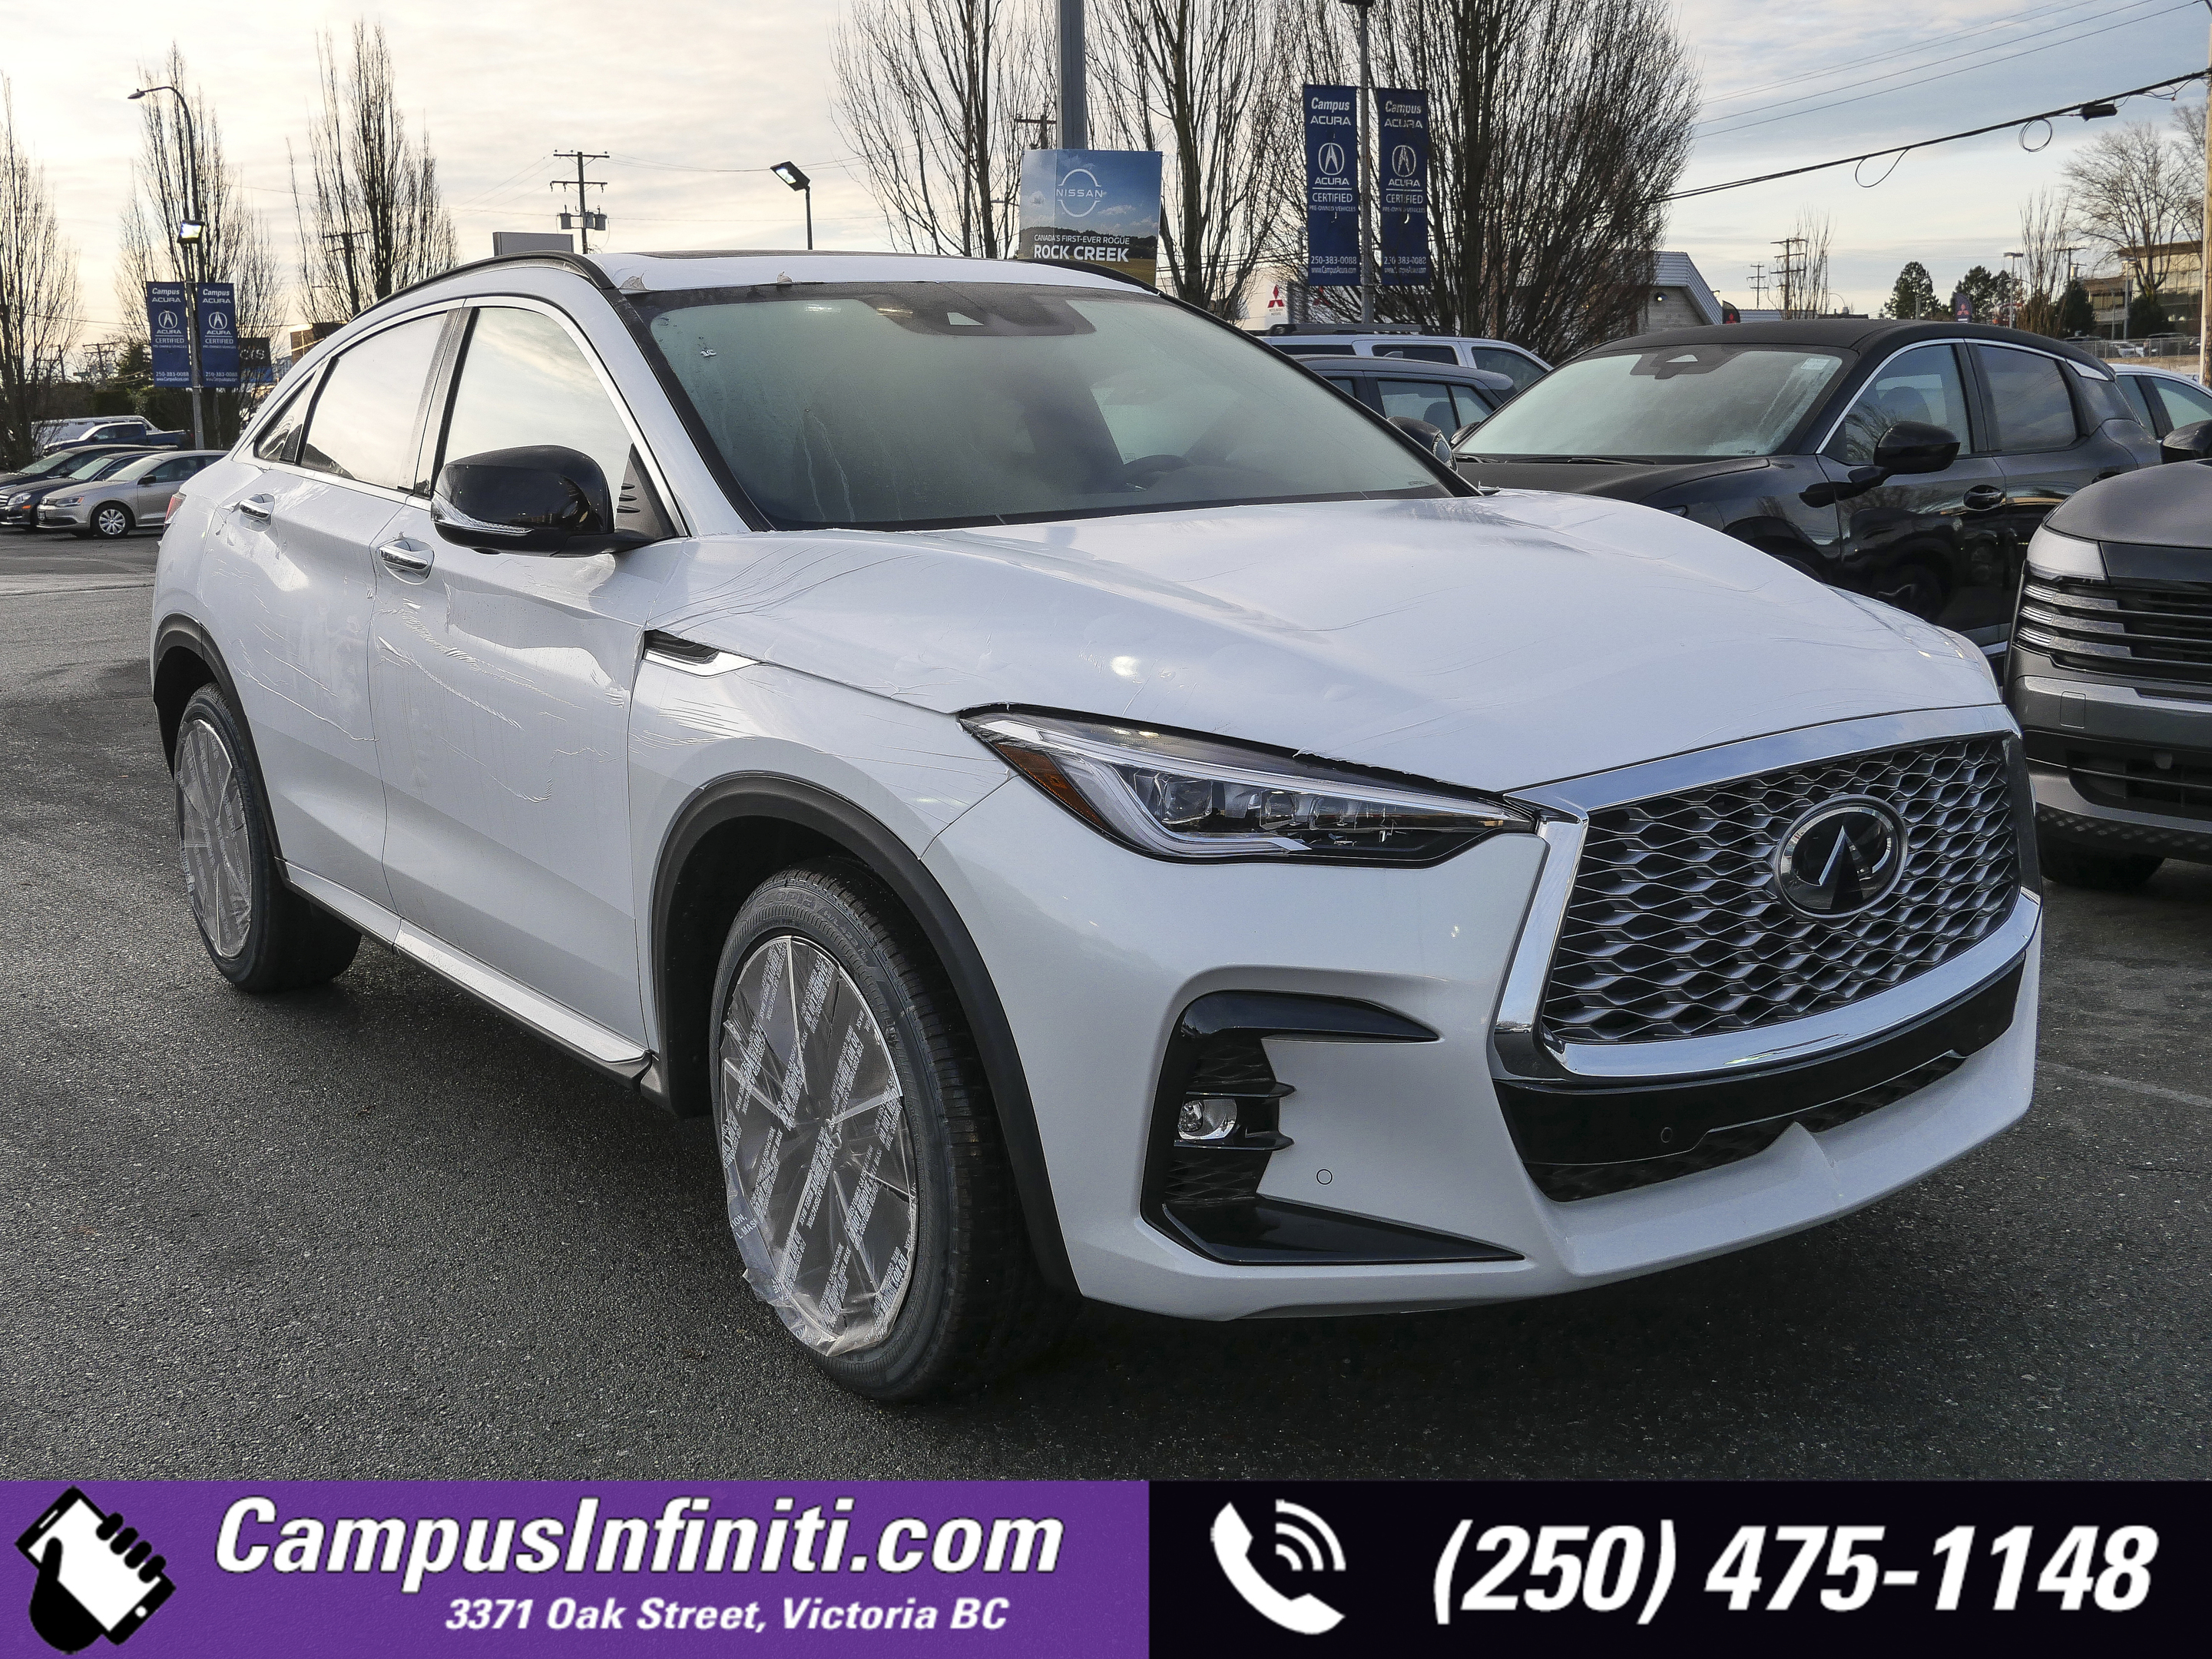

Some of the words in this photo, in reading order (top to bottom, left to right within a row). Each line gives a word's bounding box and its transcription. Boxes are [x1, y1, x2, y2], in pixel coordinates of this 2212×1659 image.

[1311, 97, 1350, 113] Campus
[1385, 101, 1421, 114] Campus
[1310, 115, 1352, 126] ACURA
[1384, 118, 1422, 128] ACURA
[1314, 177, 1349, 185] ACURA
[1388, 178, 1420, 187] ACURA
[1056, 189, 1103, 198] NISSAN
[1312, 193, 1353, 203] CERTIFIED
[1061, 235, 1101, 244] FIRST-EVER
[1103, 237, 1130, 245] ROGUE
[1034, 244, 1070, 260] ROCK
[1073, 246, 1129, 263] CREEK
[1310, 256, 1357, 264] 250-383-0088
